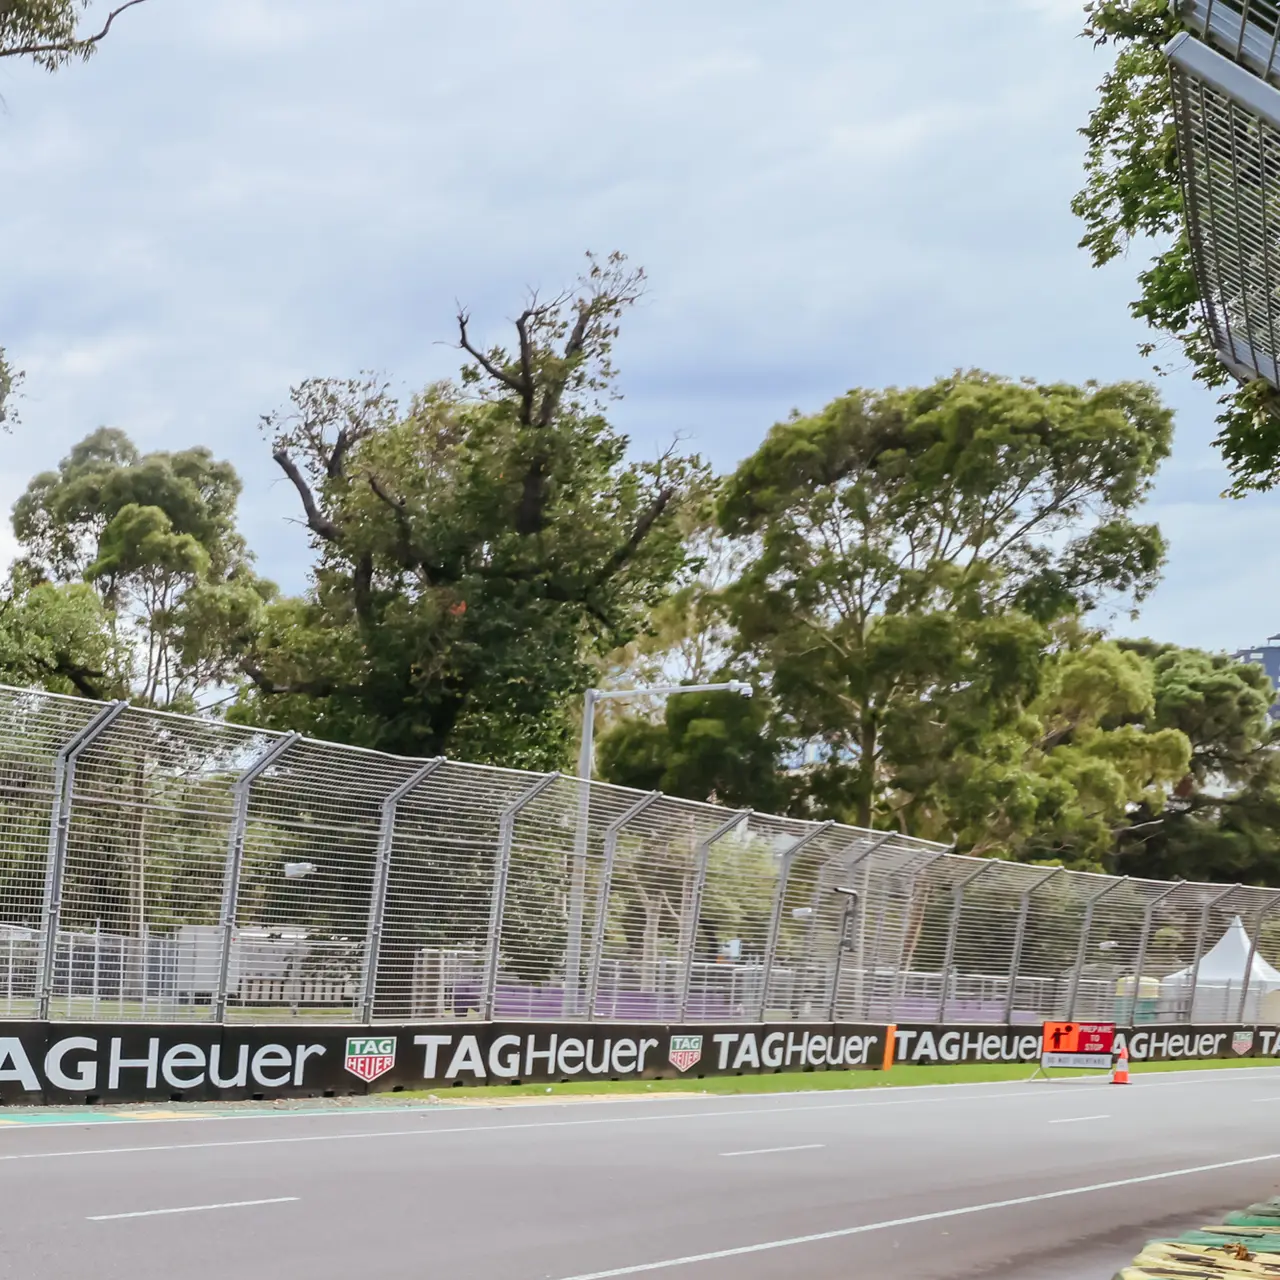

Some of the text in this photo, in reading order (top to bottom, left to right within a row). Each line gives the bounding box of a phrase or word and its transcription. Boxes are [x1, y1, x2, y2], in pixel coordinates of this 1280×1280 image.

[673, 1037, 700, 1050] TAG
[1090, 1034, 1101, 1042] TO
[350, 1039, 392, 1055] TAG
[1084, 1043, 1104, 1051] STOP
[347, 1057, 392, 1079] HEUER
